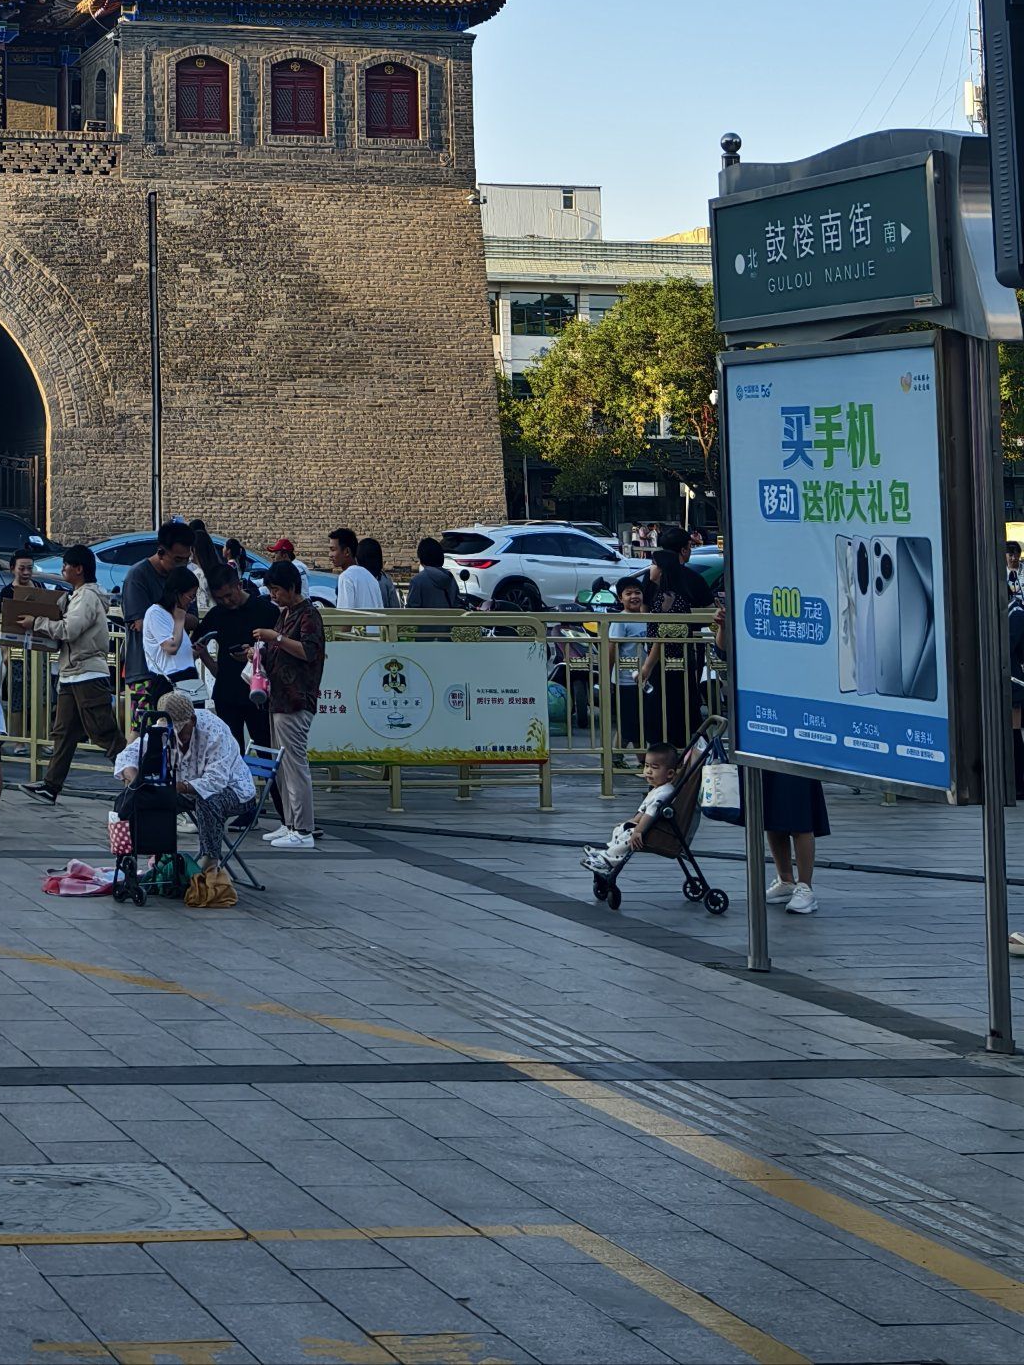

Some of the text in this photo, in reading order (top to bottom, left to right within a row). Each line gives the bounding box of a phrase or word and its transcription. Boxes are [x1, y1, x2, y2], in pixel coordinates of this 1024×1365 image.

[747, 201, 897, 269] 北 鼓楼南街 南
[768, 260, 877, 294] GULOU NANJIE
[780, 401, 881, 470] 买手机
[763, 479, 912, 524] 移动 送你大礼包
